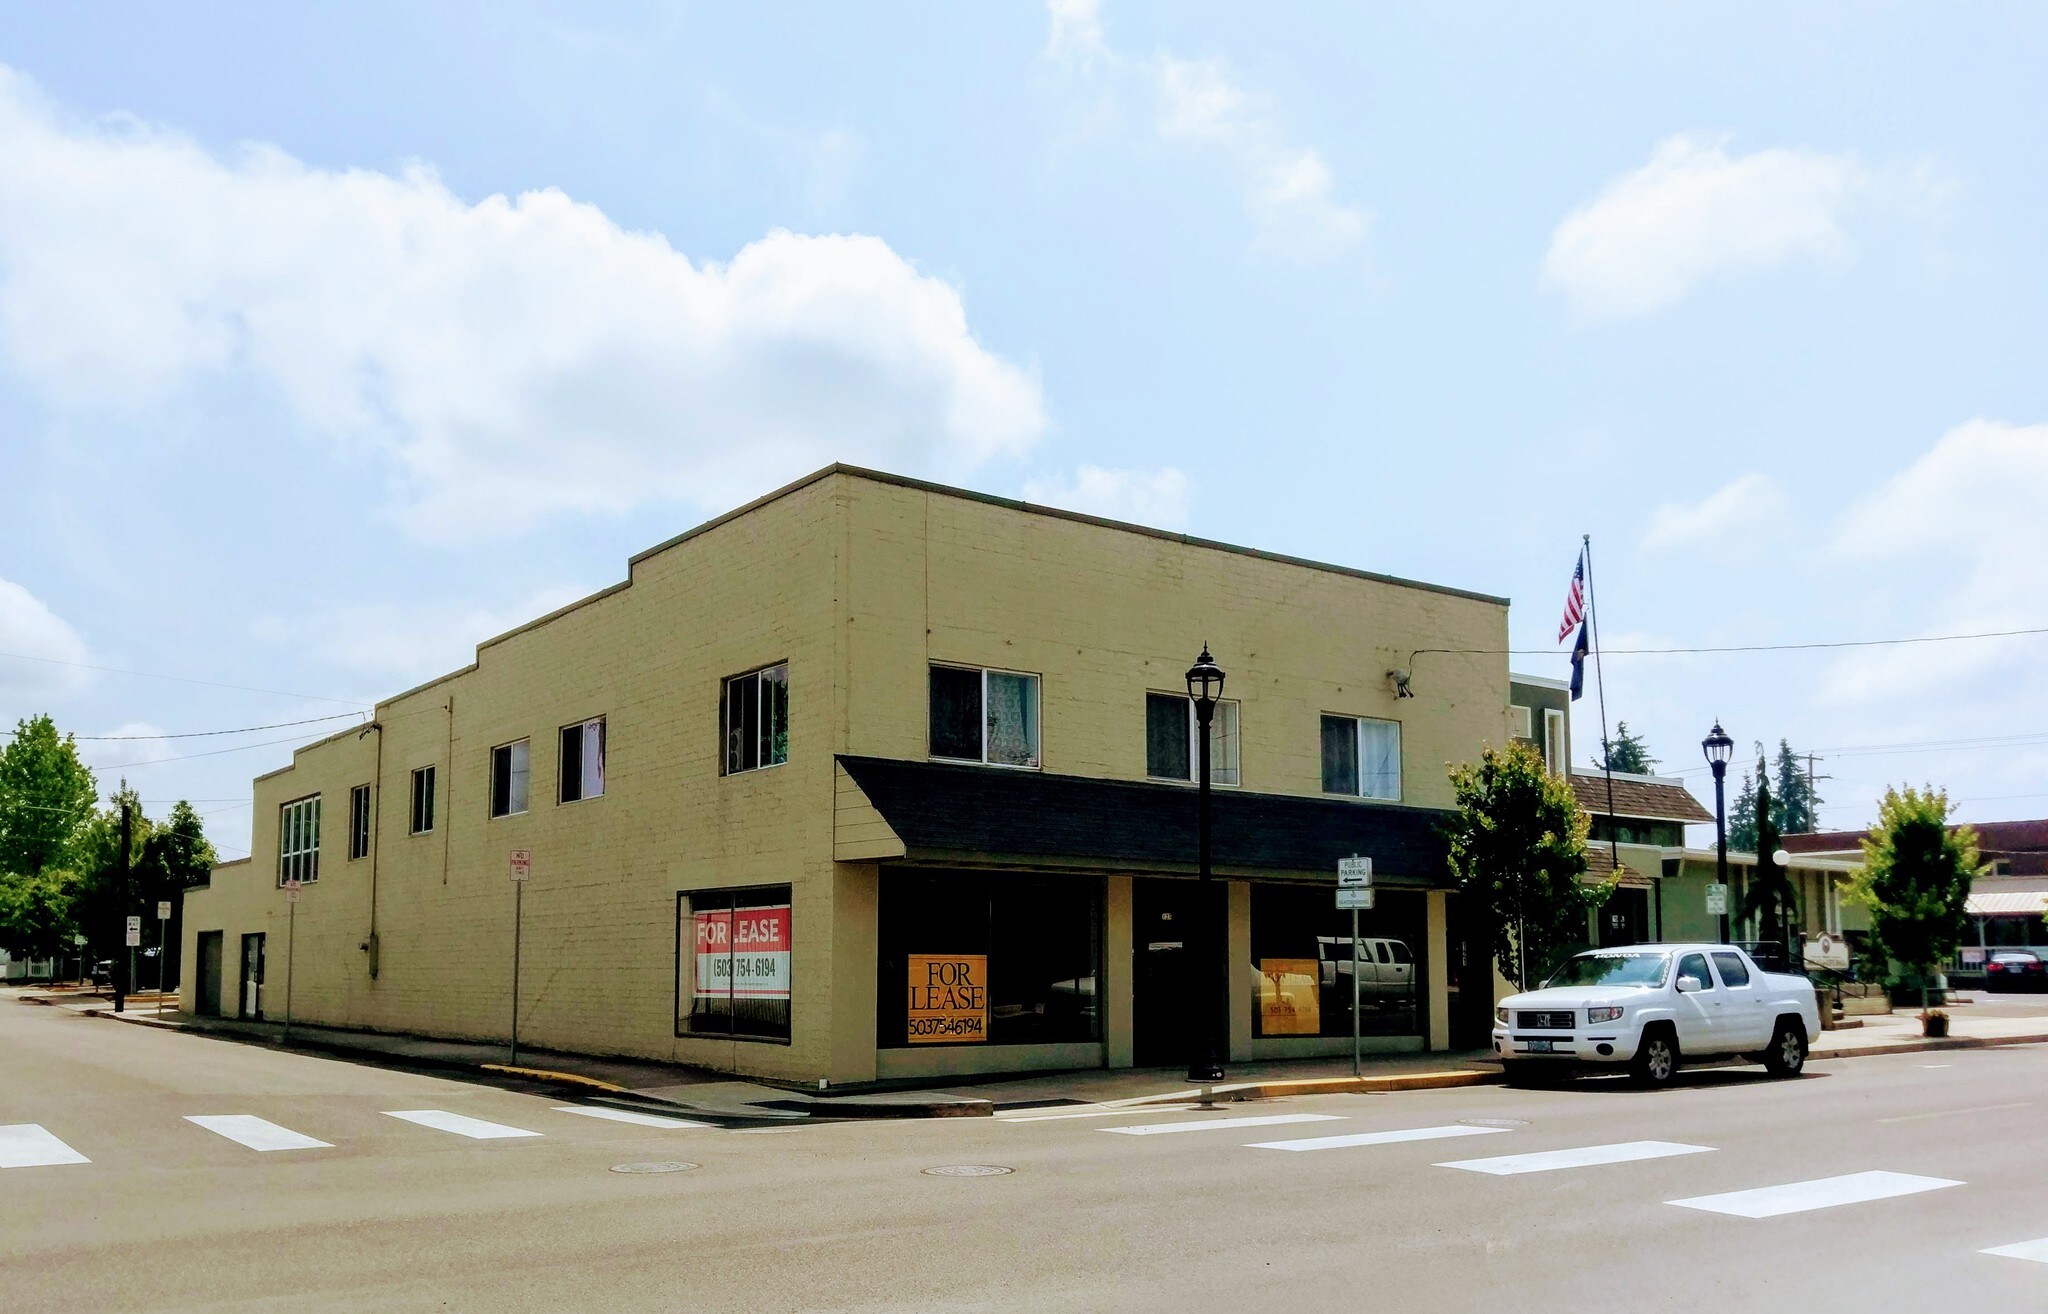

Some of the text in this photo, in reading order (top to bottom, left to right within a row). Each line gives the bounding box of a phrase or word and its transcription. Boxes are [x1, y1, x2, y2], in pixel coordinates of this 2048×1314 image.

[515, 852, 525, 860] NO
[1344, 860, 1362, 868] PUBLIC
[1340, 868, 1367, 877] PARKING
[697, 918, 780, 945] FOR EASE
[736, 957, 776, 977] 754-6194
[926, 962, 974, 986] FOR
[909, 986, 985, 1011] LEASE
[909, 1017, 983, 1036] 5037546194
